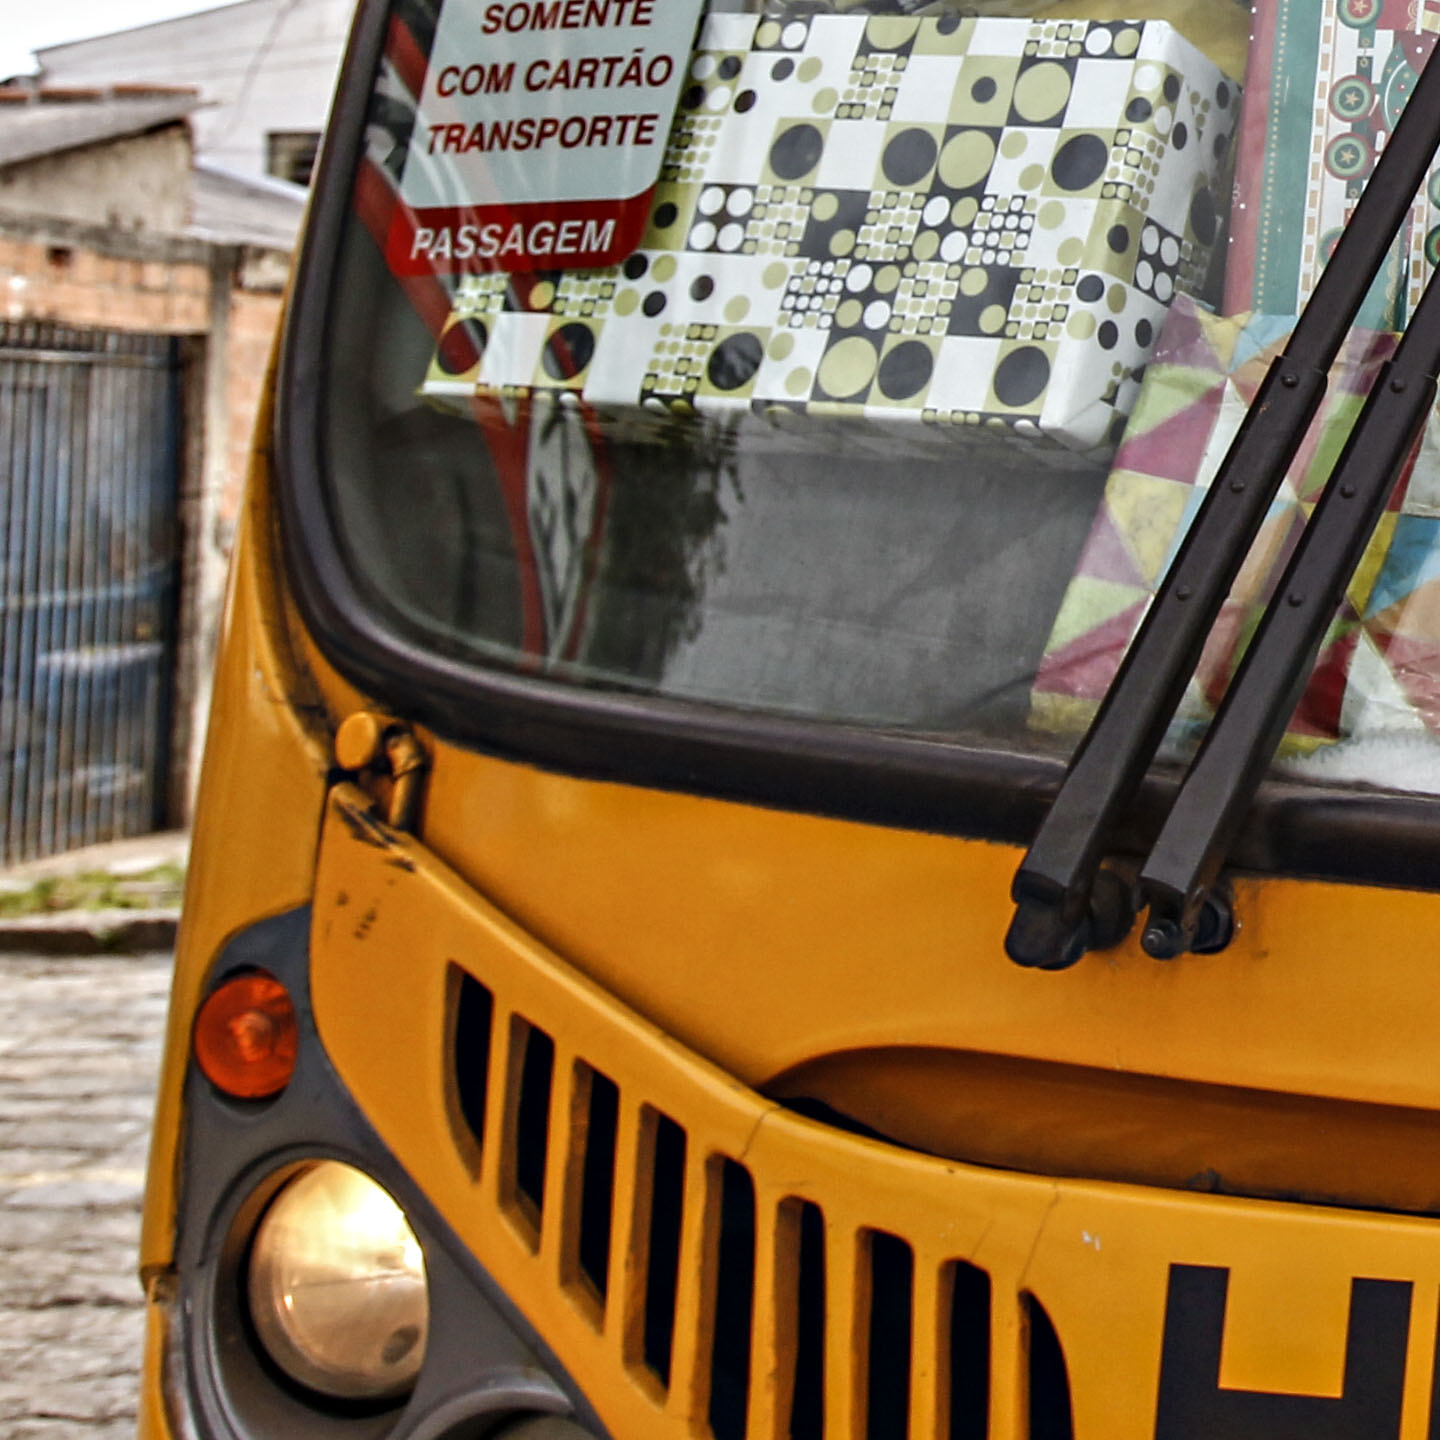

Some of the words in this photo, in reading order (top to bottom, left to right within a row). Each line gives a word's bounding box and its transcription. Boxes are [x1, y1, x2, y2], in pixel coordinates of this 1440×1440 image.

[436, 62, 515, 98] COM
[524, 47, 673, 92] CARTÃO
[427, 114, 659, 155] TRANSPORTE
[410, 219, 616, 260] PASSAGEM
